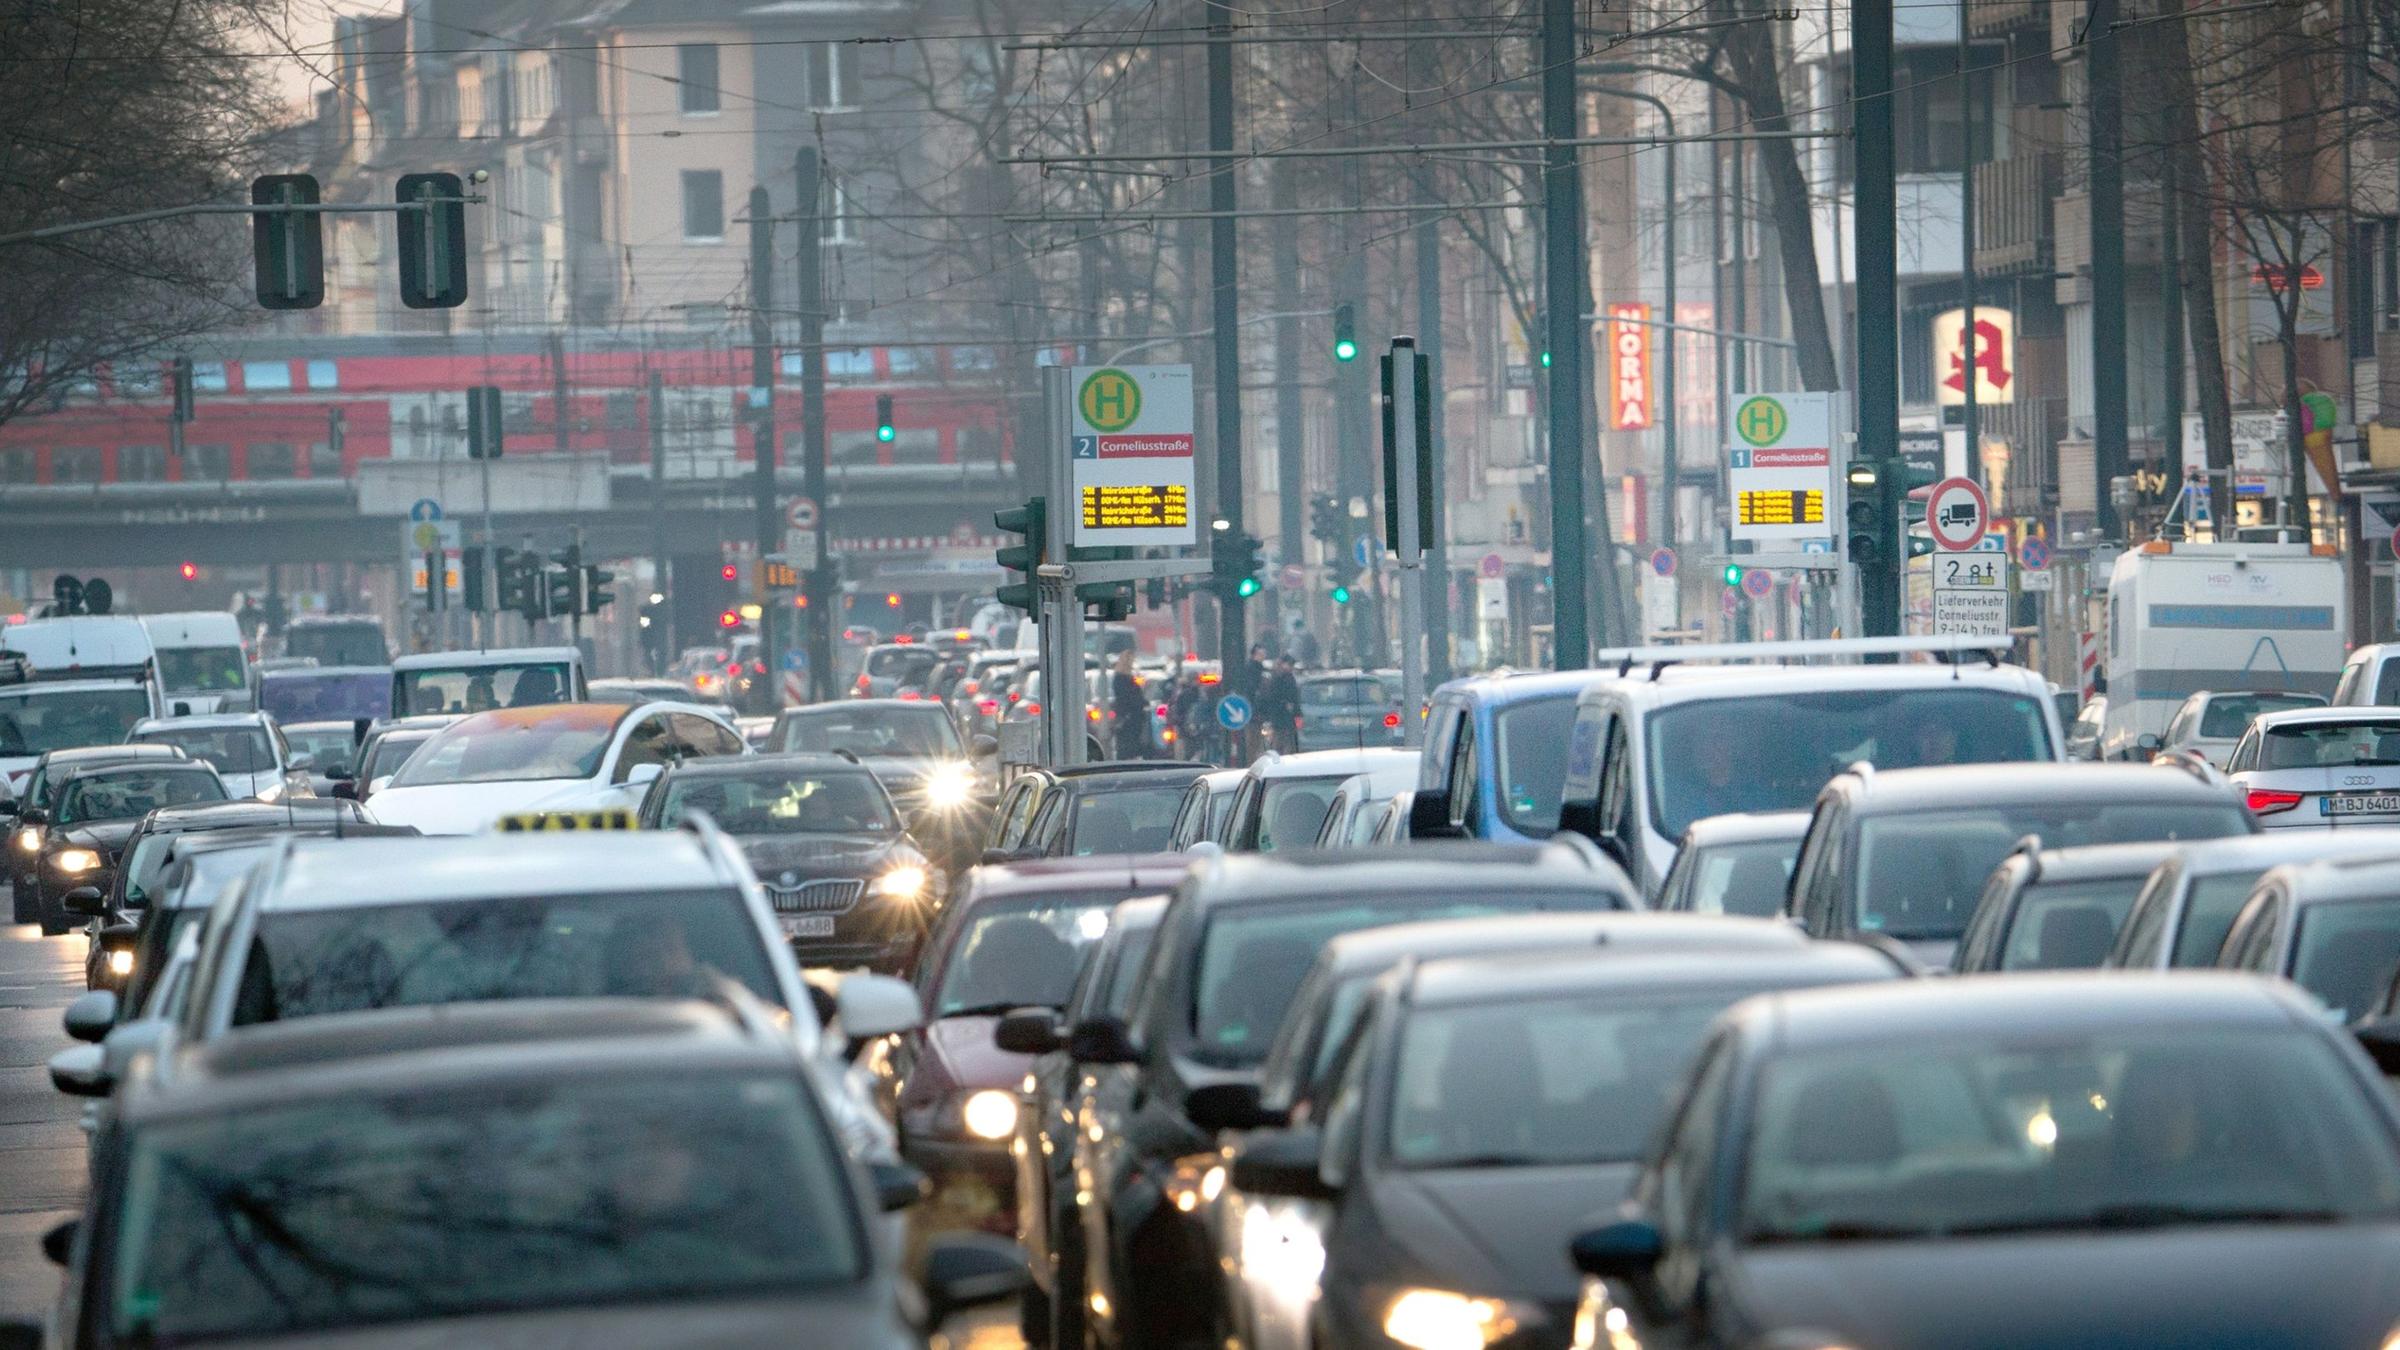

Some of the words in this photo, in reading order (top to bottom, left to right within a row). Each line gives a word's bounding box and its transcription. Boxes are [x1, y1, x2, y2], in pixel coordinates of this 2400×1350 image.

[1617, 309, 1644, 425] NORMA
[1096, 382, 1125, 419] H
[1750, 406, 1774, 436] H
[1079, 438, 1090, 456] 2
[1101, 440, 1189, 452] Corneliusstraße
[1736, 452, 1744, 466] 1
[1754, 453, 1826, 462] Corneliusstraße
[1938, 595, 2004, 606] Lieferverkehr
[1938, 609, 2000, 621] Corneliusstr.
[1983, 624, 2000, 635] frei
[2329, 799, 2338, 811] M
[2346, 798, 2364, 811] BJ
[2366, 797, 2398, 810] 6401
